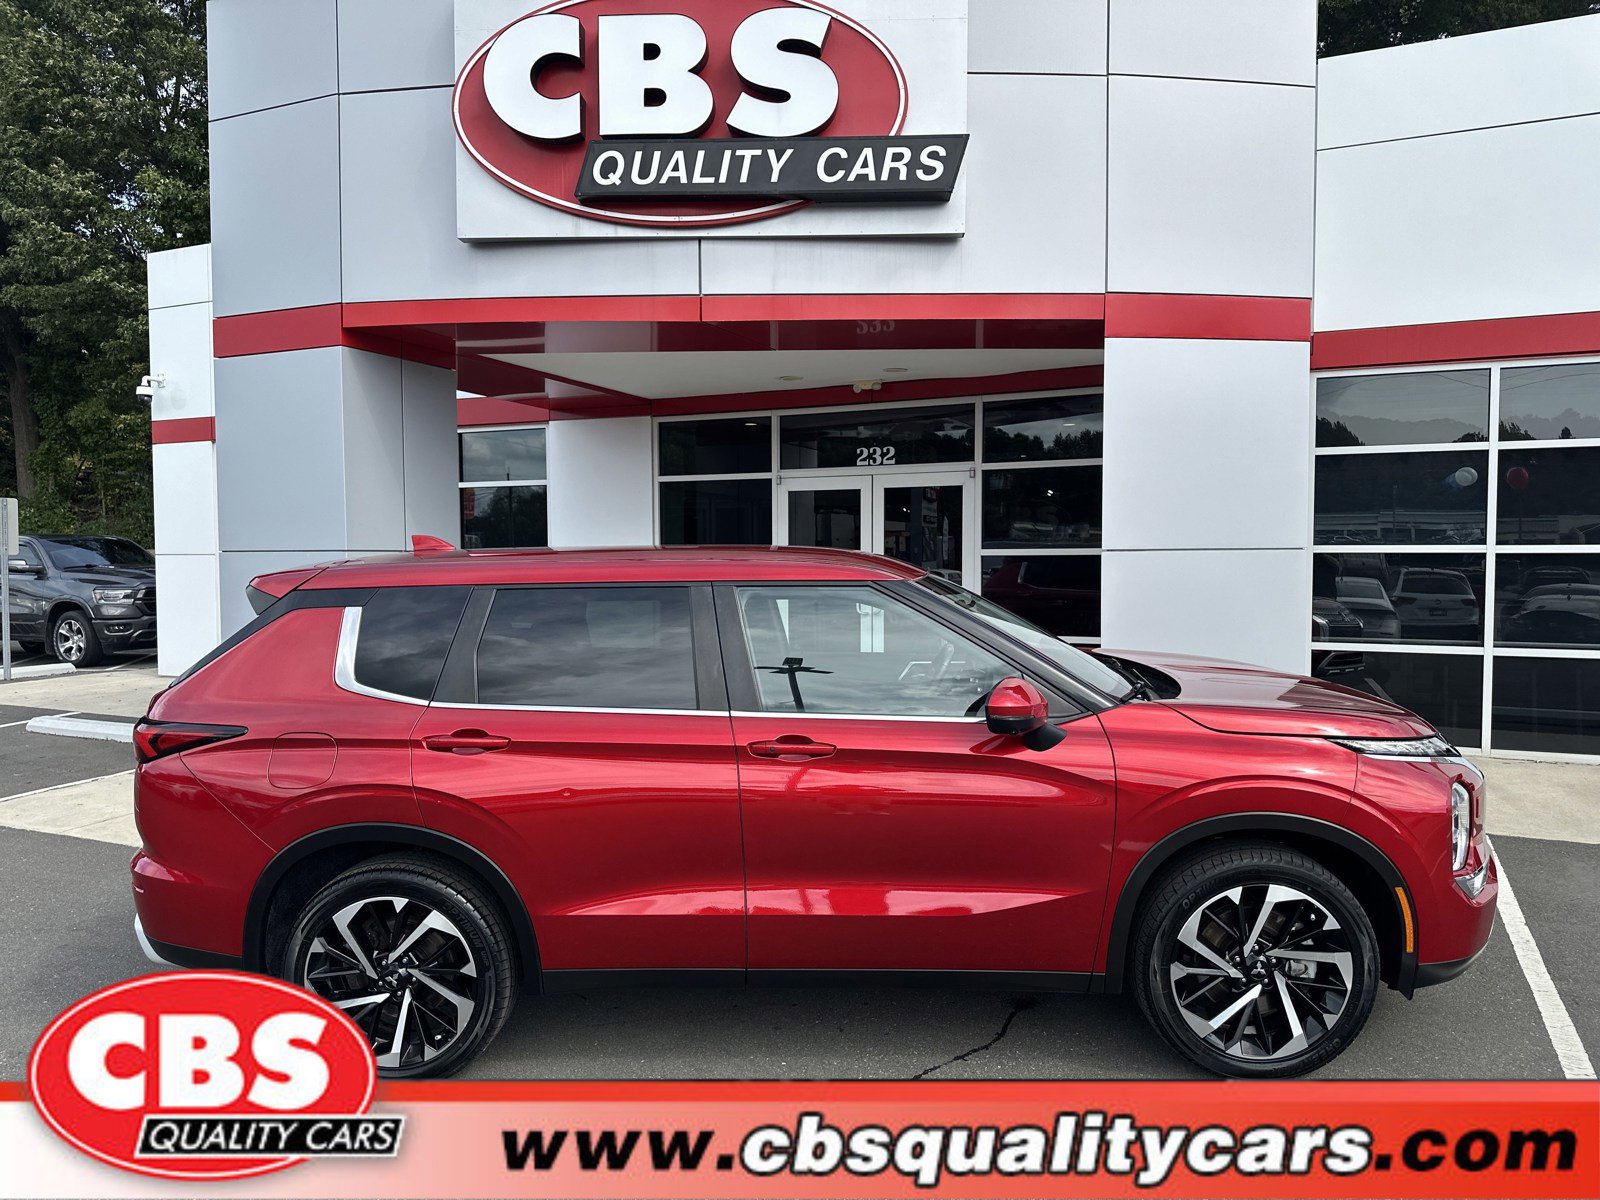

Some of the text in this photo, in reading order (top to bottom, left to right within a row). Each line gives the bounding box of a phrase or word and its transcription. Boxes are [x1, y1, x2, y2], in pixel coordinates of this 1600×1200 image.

[483, 7, 840, 140] CBS
[592, 145, 948, 187] QUALITY CARS
[856, 446, 896, 466] 232
